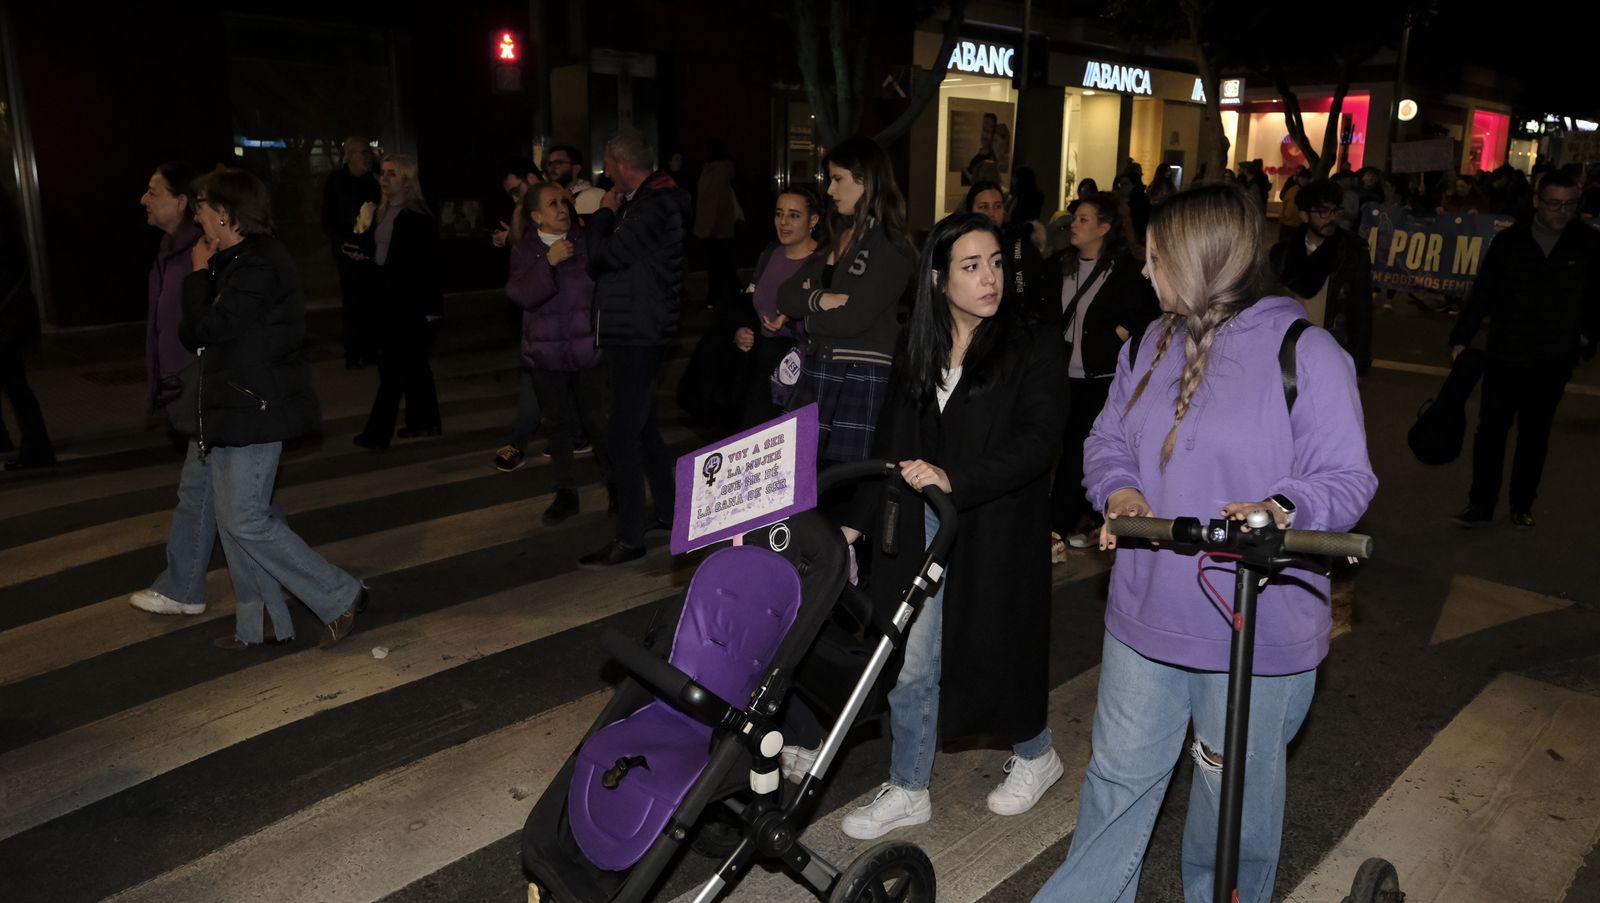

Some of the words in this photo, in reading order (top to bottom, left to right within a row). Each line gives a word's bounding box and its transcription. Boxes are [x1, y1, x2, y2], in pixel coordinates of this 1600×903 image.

[1082, 61, 1153, 95] ABANCA
[848, 249, 870, 276] S
[1387, 229, 1444, 272] POR
[727, 466, 741, 478] LA
[745, 449, 782, 472] MUJER
[728, 448, 749, 463] VOY
[752, 444, 760, 454] A
[764, 434, 785, 449] SER
[721, 480, 742, 495] QUE
[745, 473, 761, 487] ME
[764, 463, 779, 480] DÉ
[697, 506, 711, 519] LA
[715, 494, 743, 512] GANA
[747, 487, 762, 501] DE
[765, 478, 787, 494] SER
